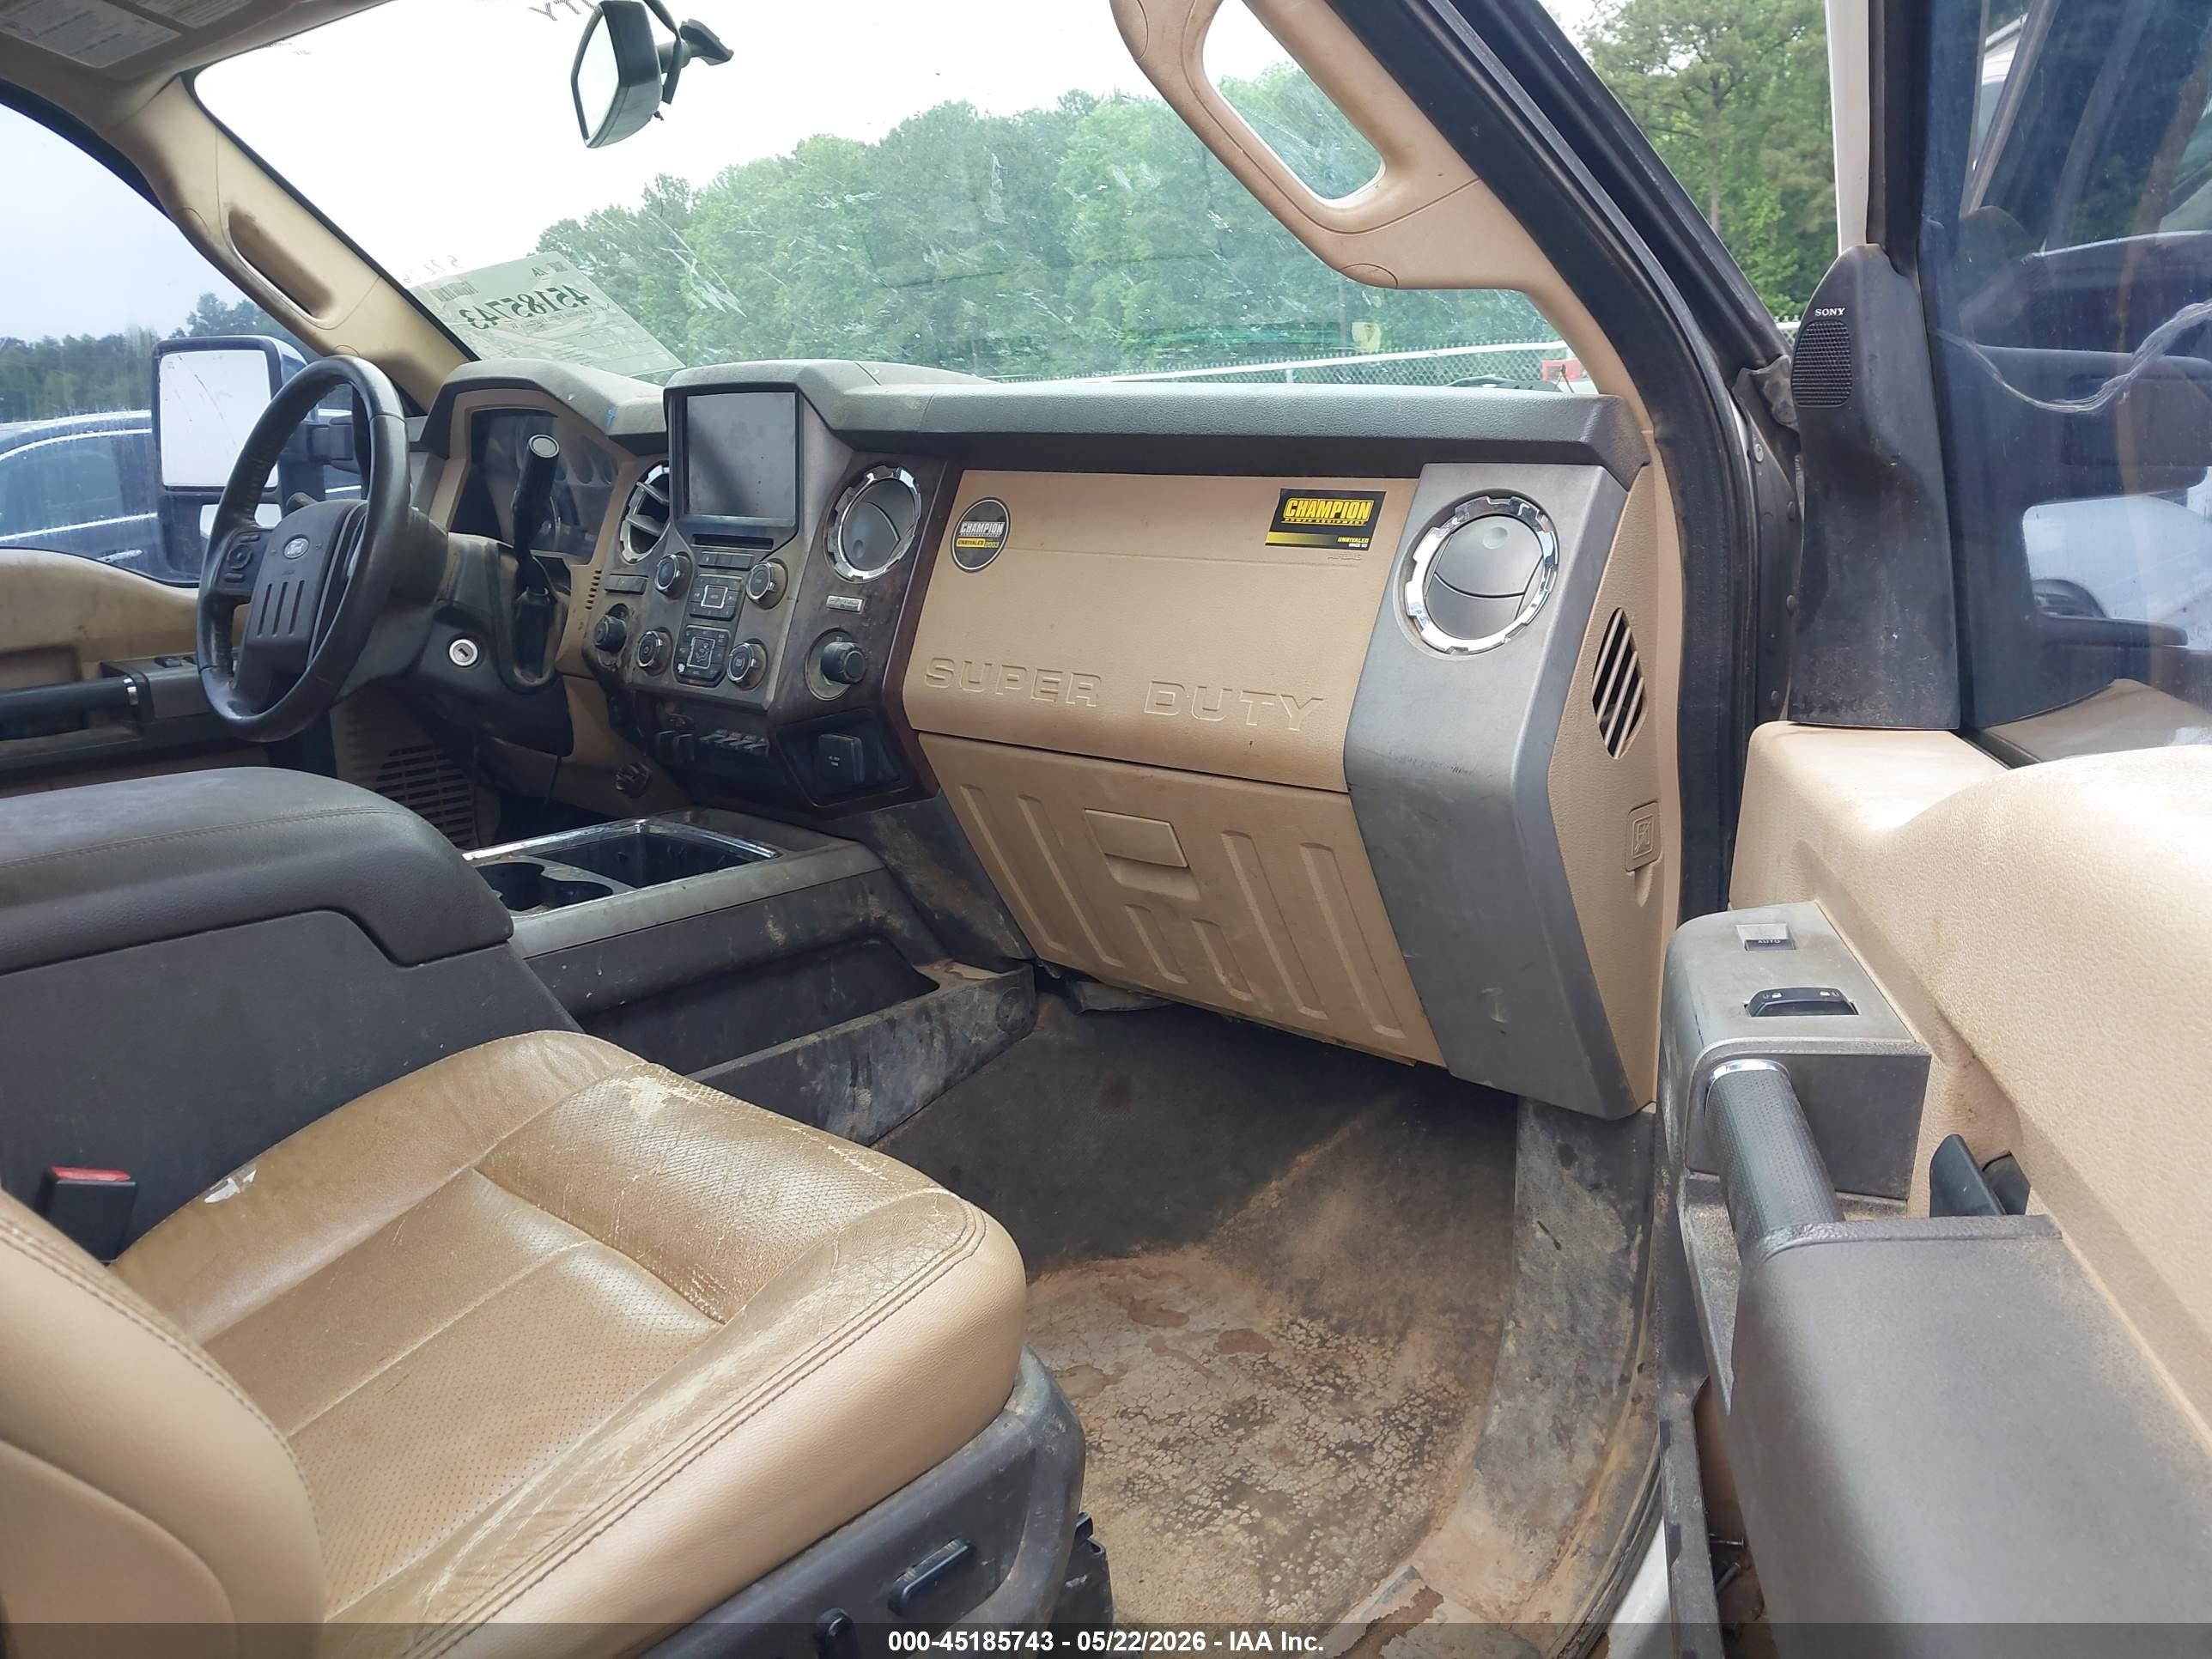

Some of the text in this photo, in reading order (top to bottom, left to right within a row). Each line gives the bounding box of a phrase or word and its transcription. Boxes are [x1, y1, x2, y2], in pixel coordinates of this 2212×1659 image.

[1814, 307, 1846, 316] SONY
[1285, 499, 1372, 520] CHAMPION
[961, 522, 1004, 532] CHAMPION
[924, 657, 1324, 731] SUPER DUTY
